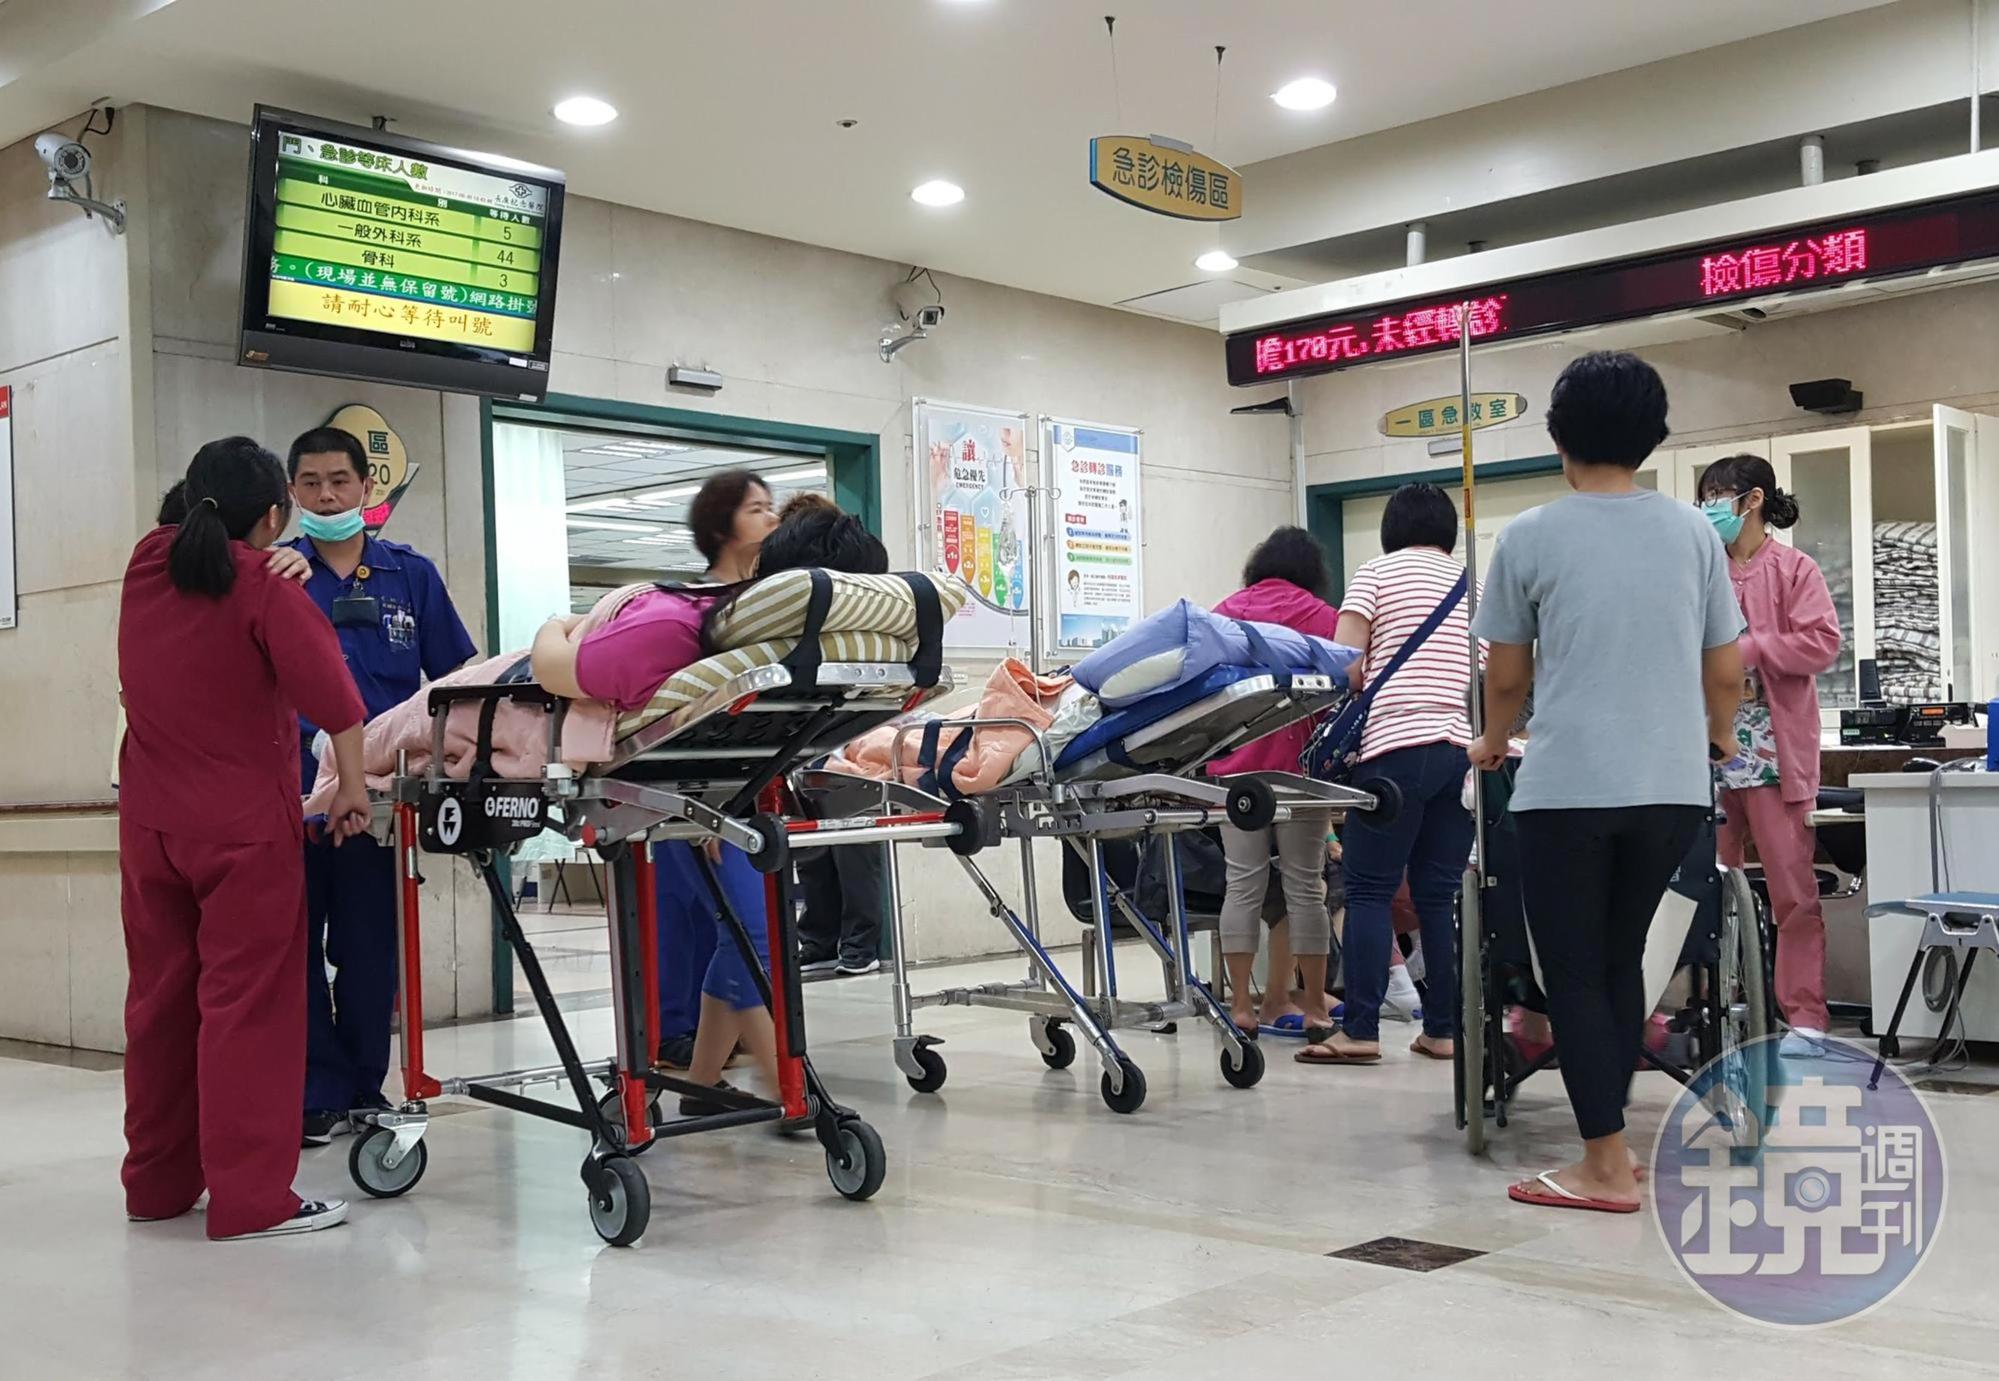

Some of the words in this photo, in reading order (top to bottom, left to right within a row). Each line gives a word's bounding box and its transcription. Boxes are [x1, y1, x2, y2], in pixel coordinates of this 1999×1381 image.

[282, 135, 429, 181] 門、急診等床人數
[318, 174, 329, 185] 科
[1112, 146, 1230, 210] 急診檢傷區
[321, 192, 440, 227] 心臟血管內科系
[489, 208, 531, 224] 等待人數
[336, 221, 422, 248] 一般外科系
[503, 226, 512, 240] 5
[361, 250, 395, 268] 骨科
[496, 250, 514, 265] 44
[1700, 229, 1868, 296] 檢傷分類
[499, 273, 508, 288] 3
[322, 293, 493, 337] 請耐心等待叫號
[367, 430, 390, 455] 區
[962, 439, 976, 462] 讓
[1071, 459, 1123, 478] 急診轉診服務
[495, 796, 539, 819] FERNO
